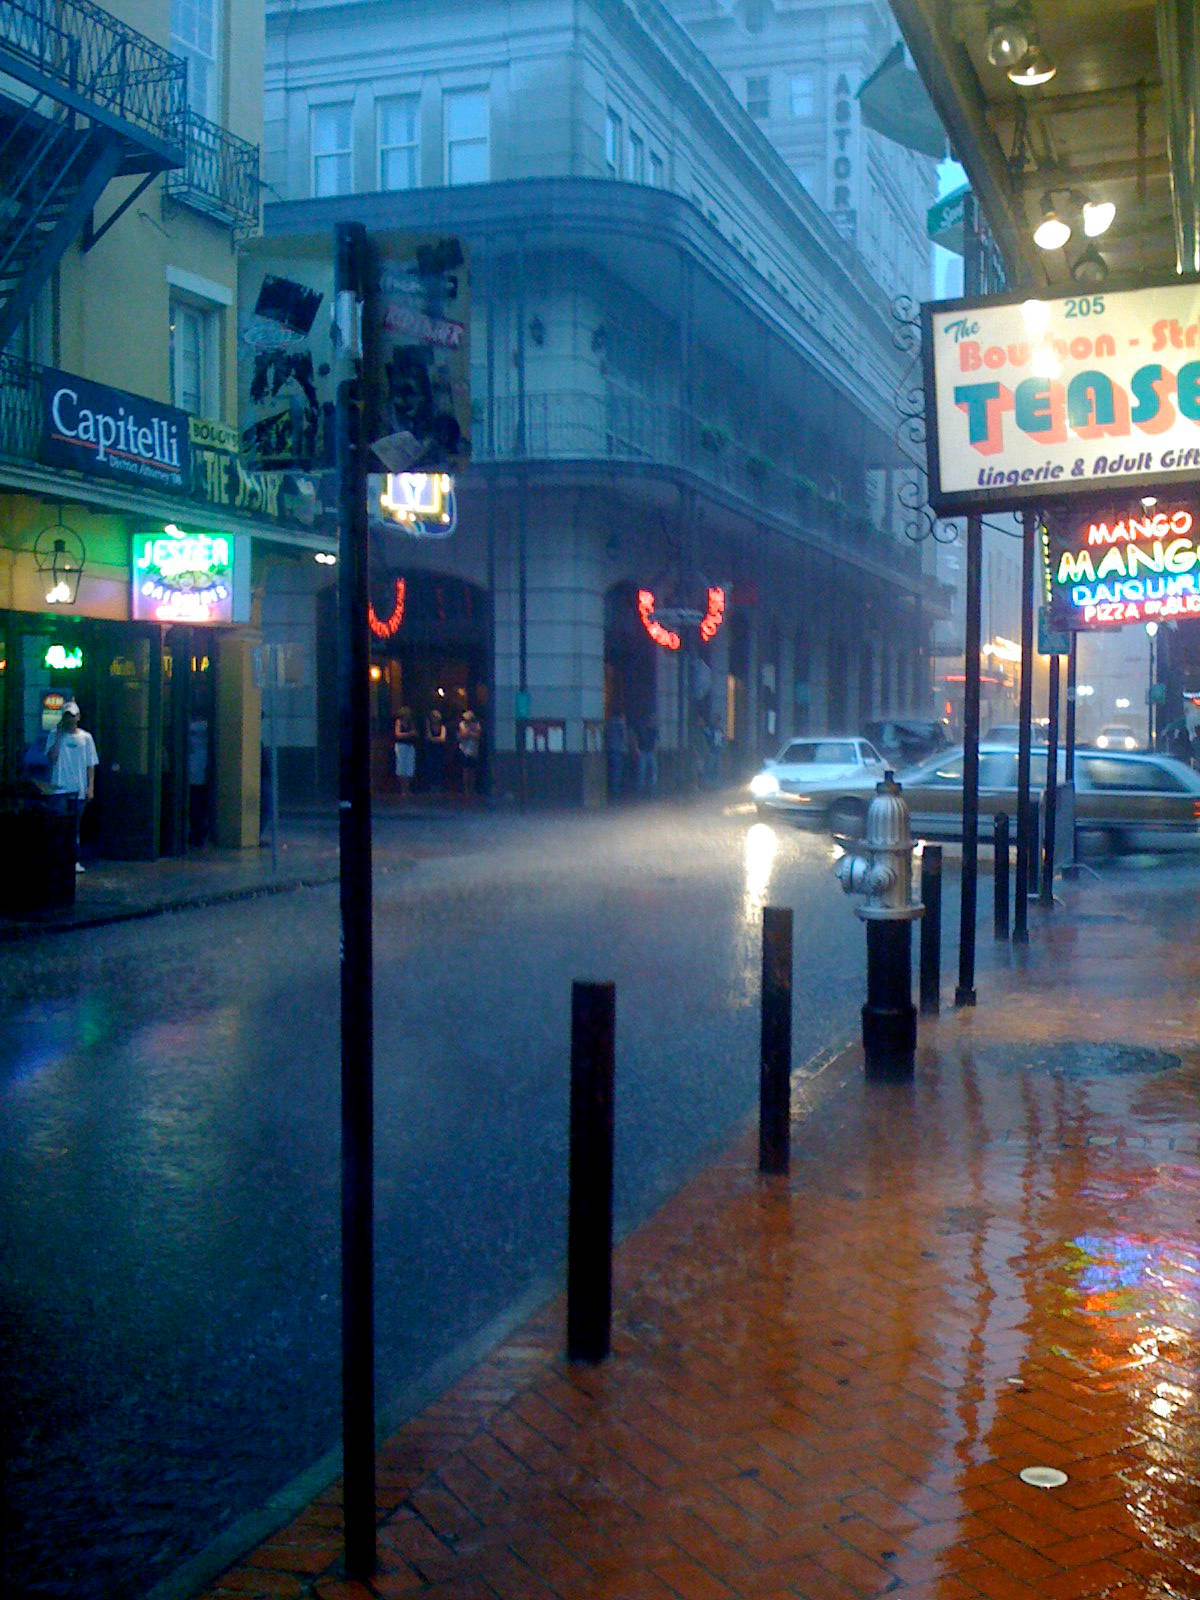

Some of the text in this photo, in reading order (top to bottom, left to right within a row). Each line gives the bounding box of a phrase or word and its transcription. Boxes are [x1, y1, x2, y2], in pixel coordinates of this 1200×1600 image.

[1064, 296, 1105, 318] 205
[944, 317, 979, 343] The
[959, 332, 1116, 373] Boubon
[954, 360, 1200, 456] TEASE
[52, 388, 180, 462] Capitelli
[977, 461, 1063, 486] Lingerie
[1071, 458, 1085, 476] &
[1092, 453, 1152, 475] Adult
[1088, 511, 1193, 545] MANGO
[1058, 538, 1200, 583] MANG
[1071, 574, 1200, 606] DAIQUIR
[1084, 602, 1140, 622] PIZZA
